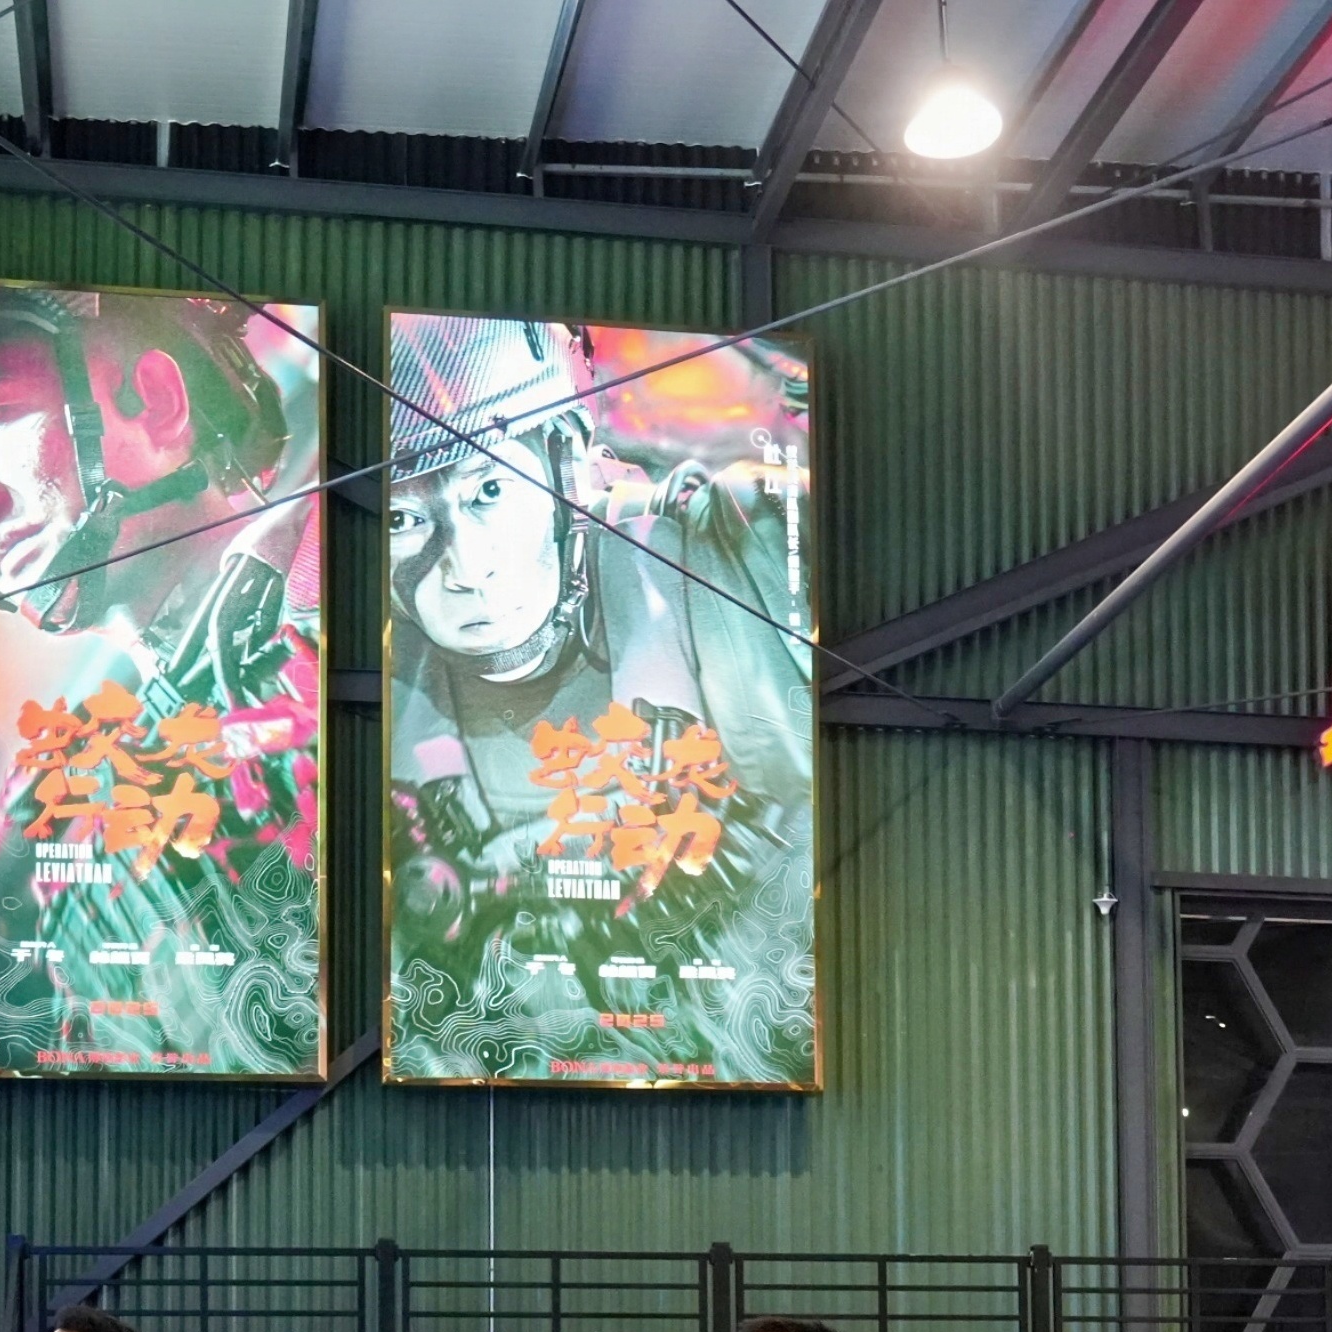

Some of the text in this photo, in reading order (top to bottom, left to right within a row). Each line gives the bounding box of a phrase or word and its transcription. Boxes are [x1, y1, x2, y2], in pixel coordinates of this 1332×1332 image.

[23, 768, 221, 882] 行动
[35, 842, 93, 859] OPERATION
[537, 787, 721, 900] 行动
[35, 862, 112, 883] LEVIATHAN
[548, 860, 602, 876] OPERATION
[548, 879, 620, 900] LEVIATHAN
